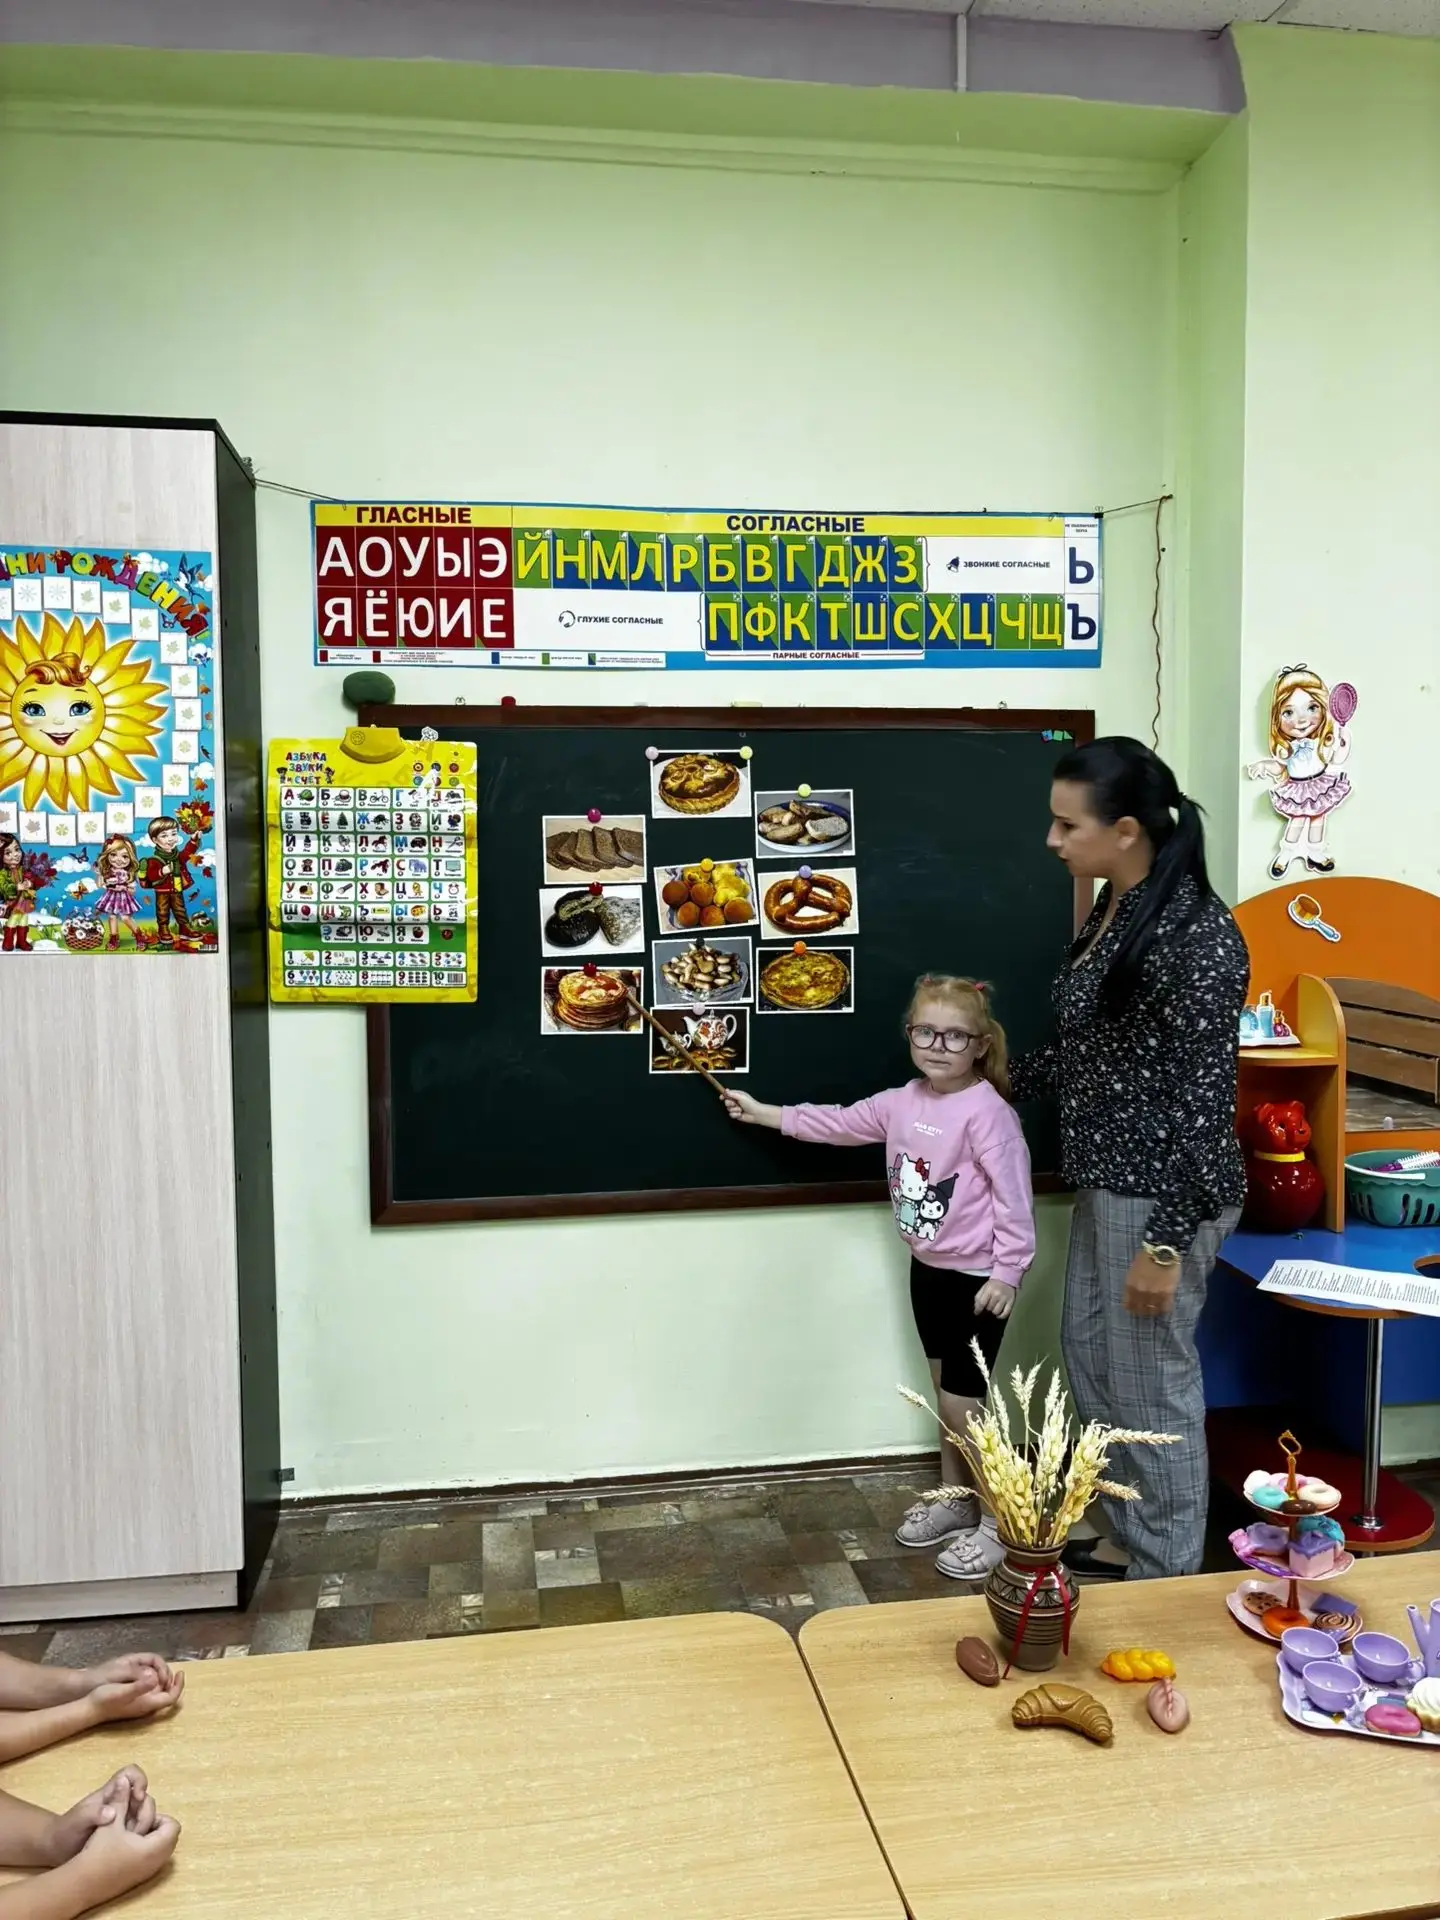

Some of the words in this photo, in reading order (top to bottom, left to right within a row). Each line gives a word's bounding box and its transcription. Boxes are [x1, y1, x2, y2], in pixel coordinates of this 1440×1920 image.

[357, 507, 471, 523] ГЛАСНЫЕ
[726, 515, 865, 533] СОГЛАСНЫЕ
[1069, 547, 1094, 584] Ь
[1067, 603, 1096, 640] Ъ
[286, 752, 327, 761] АЗБУКА
[289, 763, 323, 772] ЗВУКИ
